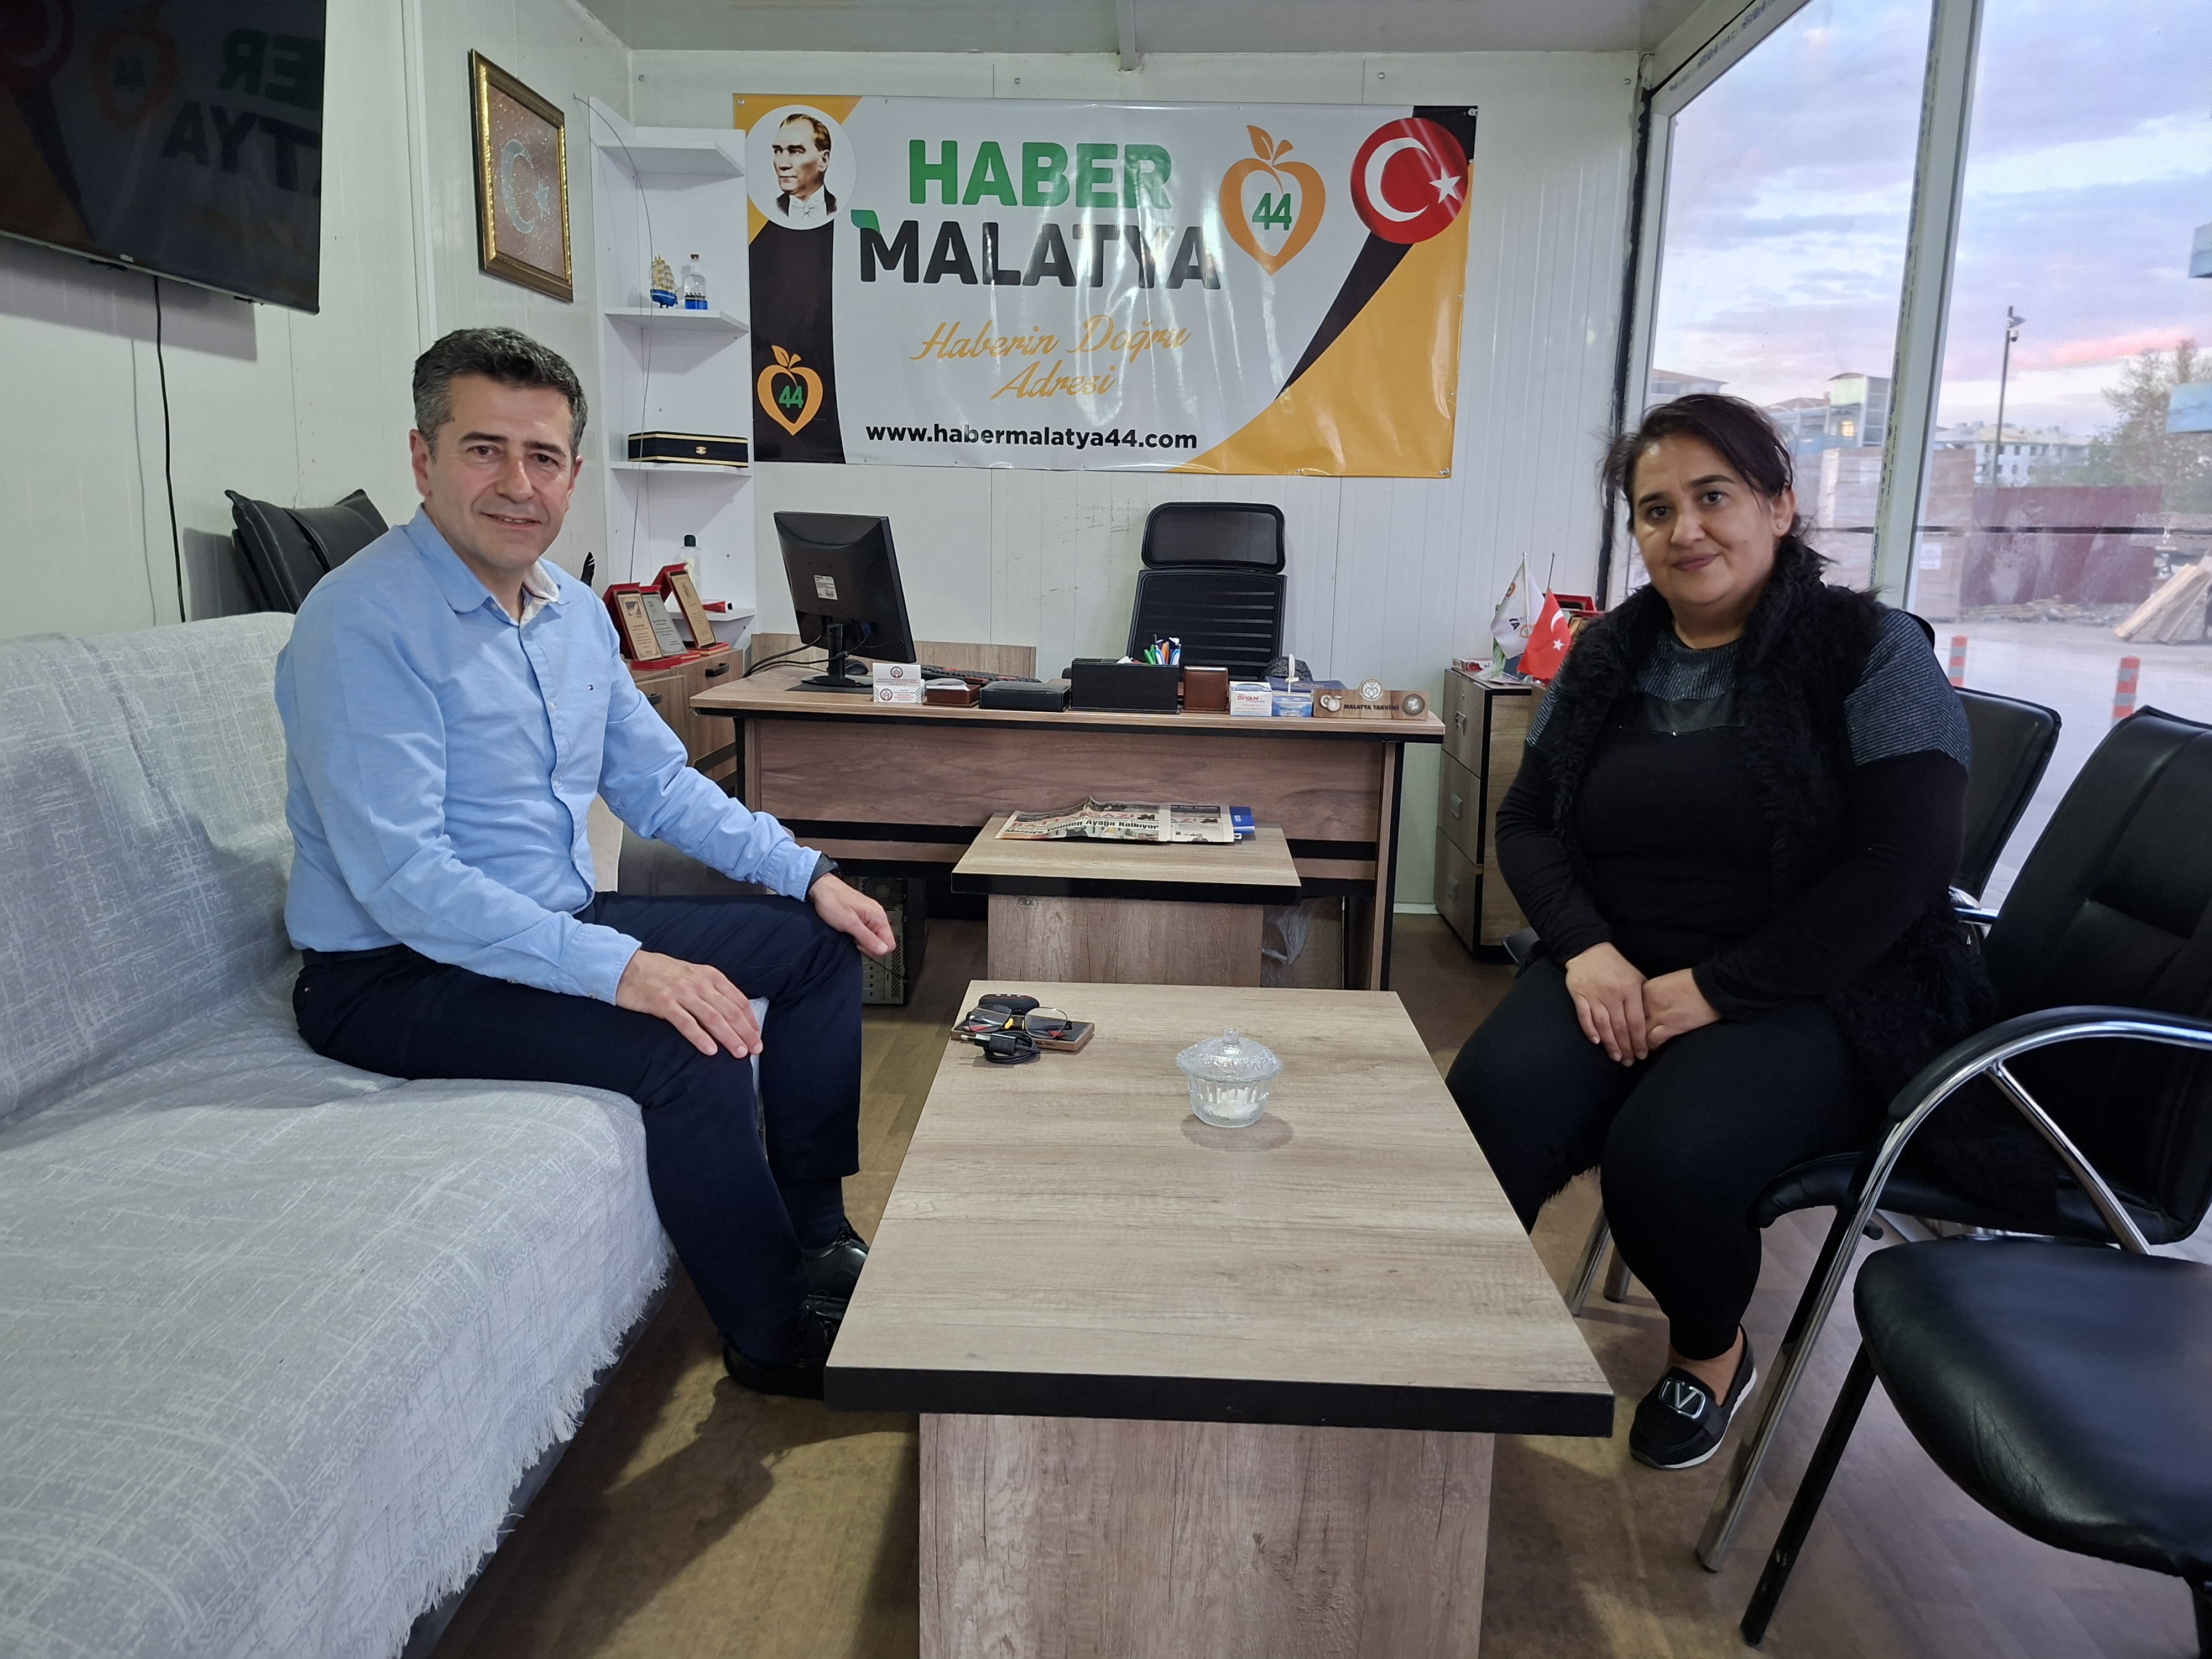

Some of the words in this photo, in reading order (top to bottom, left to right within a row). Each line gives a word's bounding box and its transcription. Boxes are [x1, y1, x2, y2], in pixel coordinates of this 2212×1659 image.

[909, 139, 1172, 209] HABER
[1252, 192, 1292, 231] 44
[860, 220, 1222, 289] MALATYA
[910, 320, 1060, 361] Haberin
[1065, 314, 1192, 363] Doğru
[779, 385, 804, 408] 44
[989, 359, 1116, 400] Adresi
[865, 424, 1198, 450] www.habermalatya44.com
